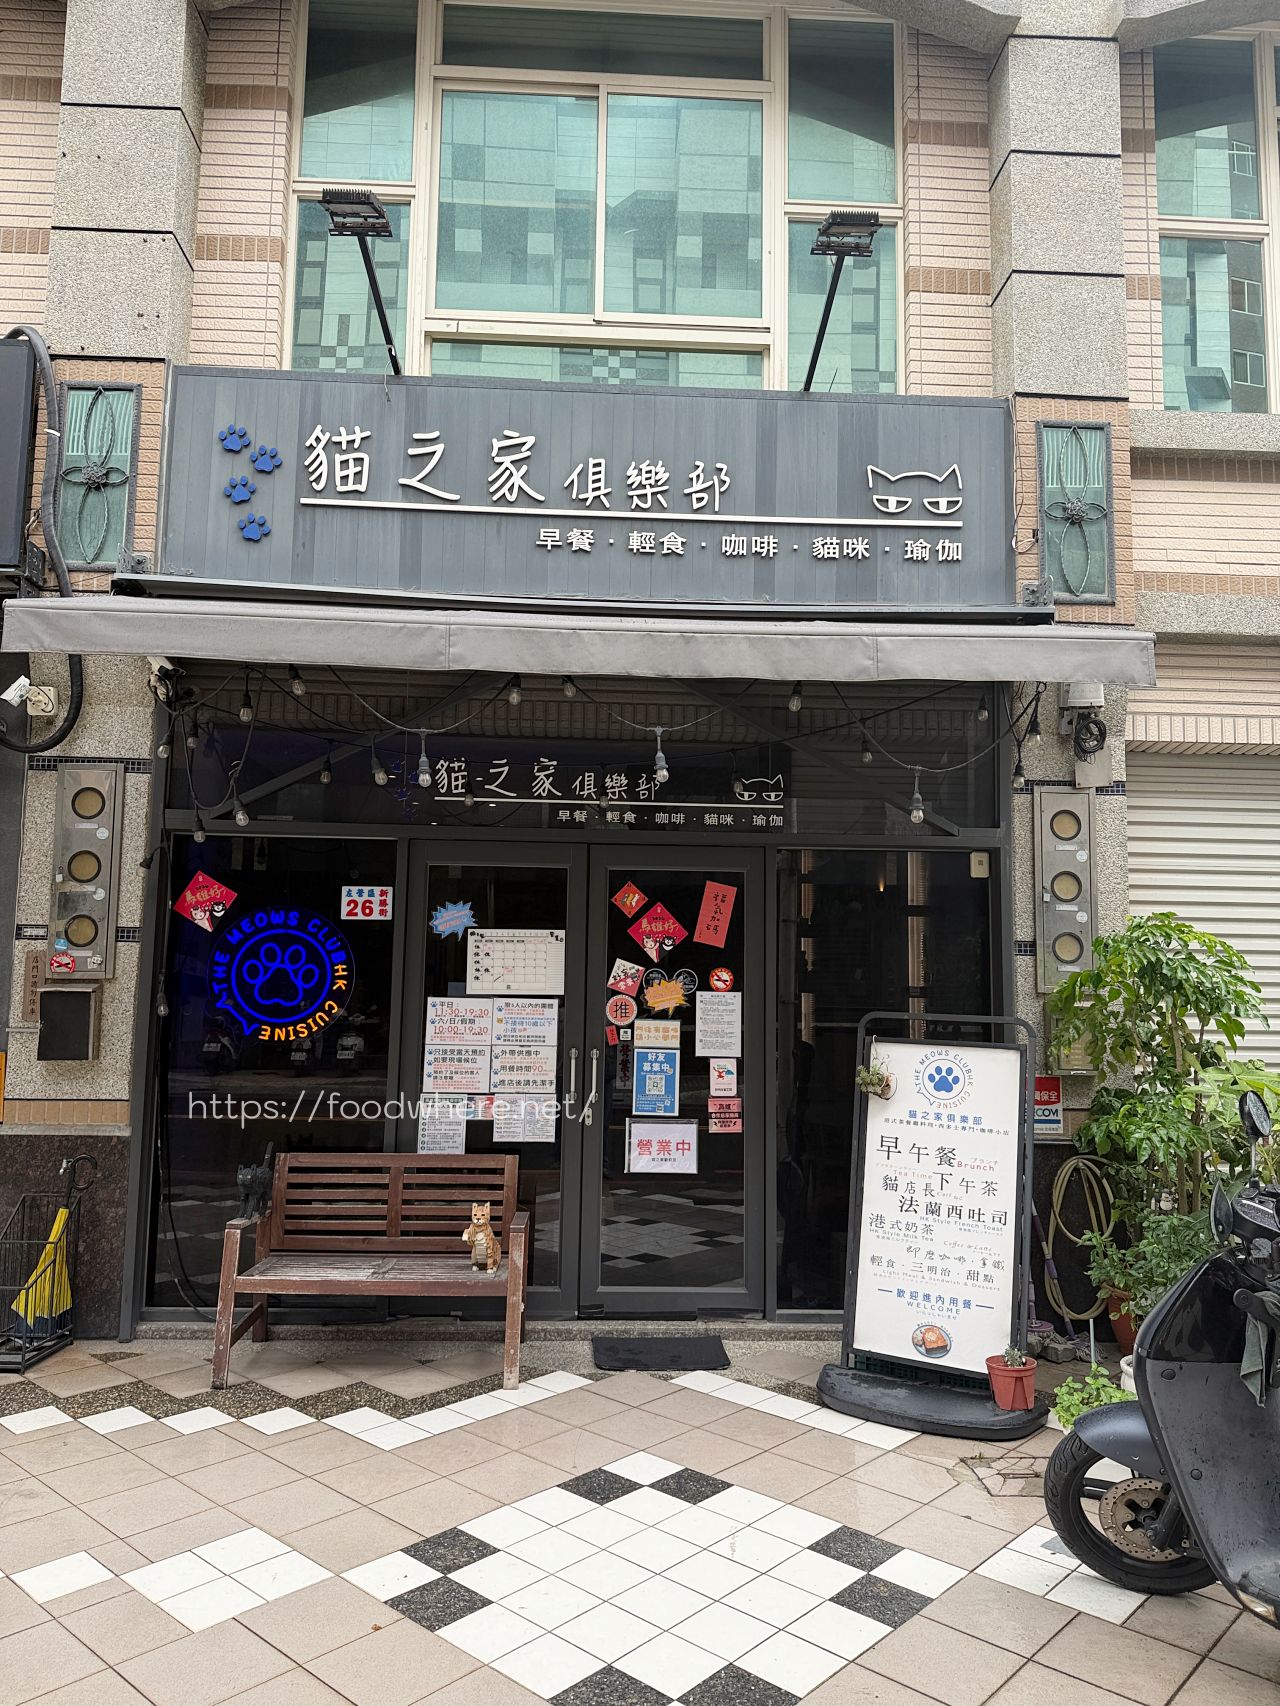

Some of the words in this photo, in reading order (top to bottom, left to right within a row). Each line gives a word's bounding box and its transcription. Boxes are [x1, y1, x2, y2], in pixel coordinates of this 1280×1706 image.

[304, 424, 731, 512] 貓之家俱樂部
[434, 757, 661, 801] 貓之家俱樂部
[345, 888, 375, 898] 左營區
[345, 899, 374, 917] 26
[212, 951, 230, 994] THE
[226, 910, 300, 945] MEOWS
[307, 918, 347, 964] CLUB
[332, 964, 348, 990] HK
[435, 1008, 489, 1016] 11:30-19:30
[613, 1001, 630, 1018] 推
[259, 1000, 339, 1041] CUISINE
[433, 1048, 486, 1056] 只接受當天預約
[500, 1049, 541, 1057] 外帶供應中
[647, 1053, 665, 1062] 好友
[642, 1062, 670, 1072] 募集中
[919, 1049, 950, 1066] MEOWS
[953, 1053, 972, 1075] CLUB
[936, 1090, 971, 1109] CUISINE
[908, 1109, 983, 1125] 貓之家俱樂部
[637, 1138, 691, 1156] 營業中
[876, 1134, 958, 1168] 早午餐
[893, 1169, 908, 1177] Tea
[912, 1171, 933, 1180] Time
[957, 1160, 995, 1172] Brunch
[882, 1174, 936, 1197] 貓店長
[933, 1171, 999, 1197] 下午茶
[898, 1195, 1008, 1226] 法蘭西吐司
[869, 1213, 935, 1236] 港式奶茶
[932, 1217, 951, 1226] Style
[954, 1220, 980, 1230] French
[983, 1224, 1004, 1233] Toast
[903, 1232, 919, 1240] Milk
[896, 1288, 972, 1310] 歡迎進內用餐
[906, 1300, 961, 1315] WELCOME
